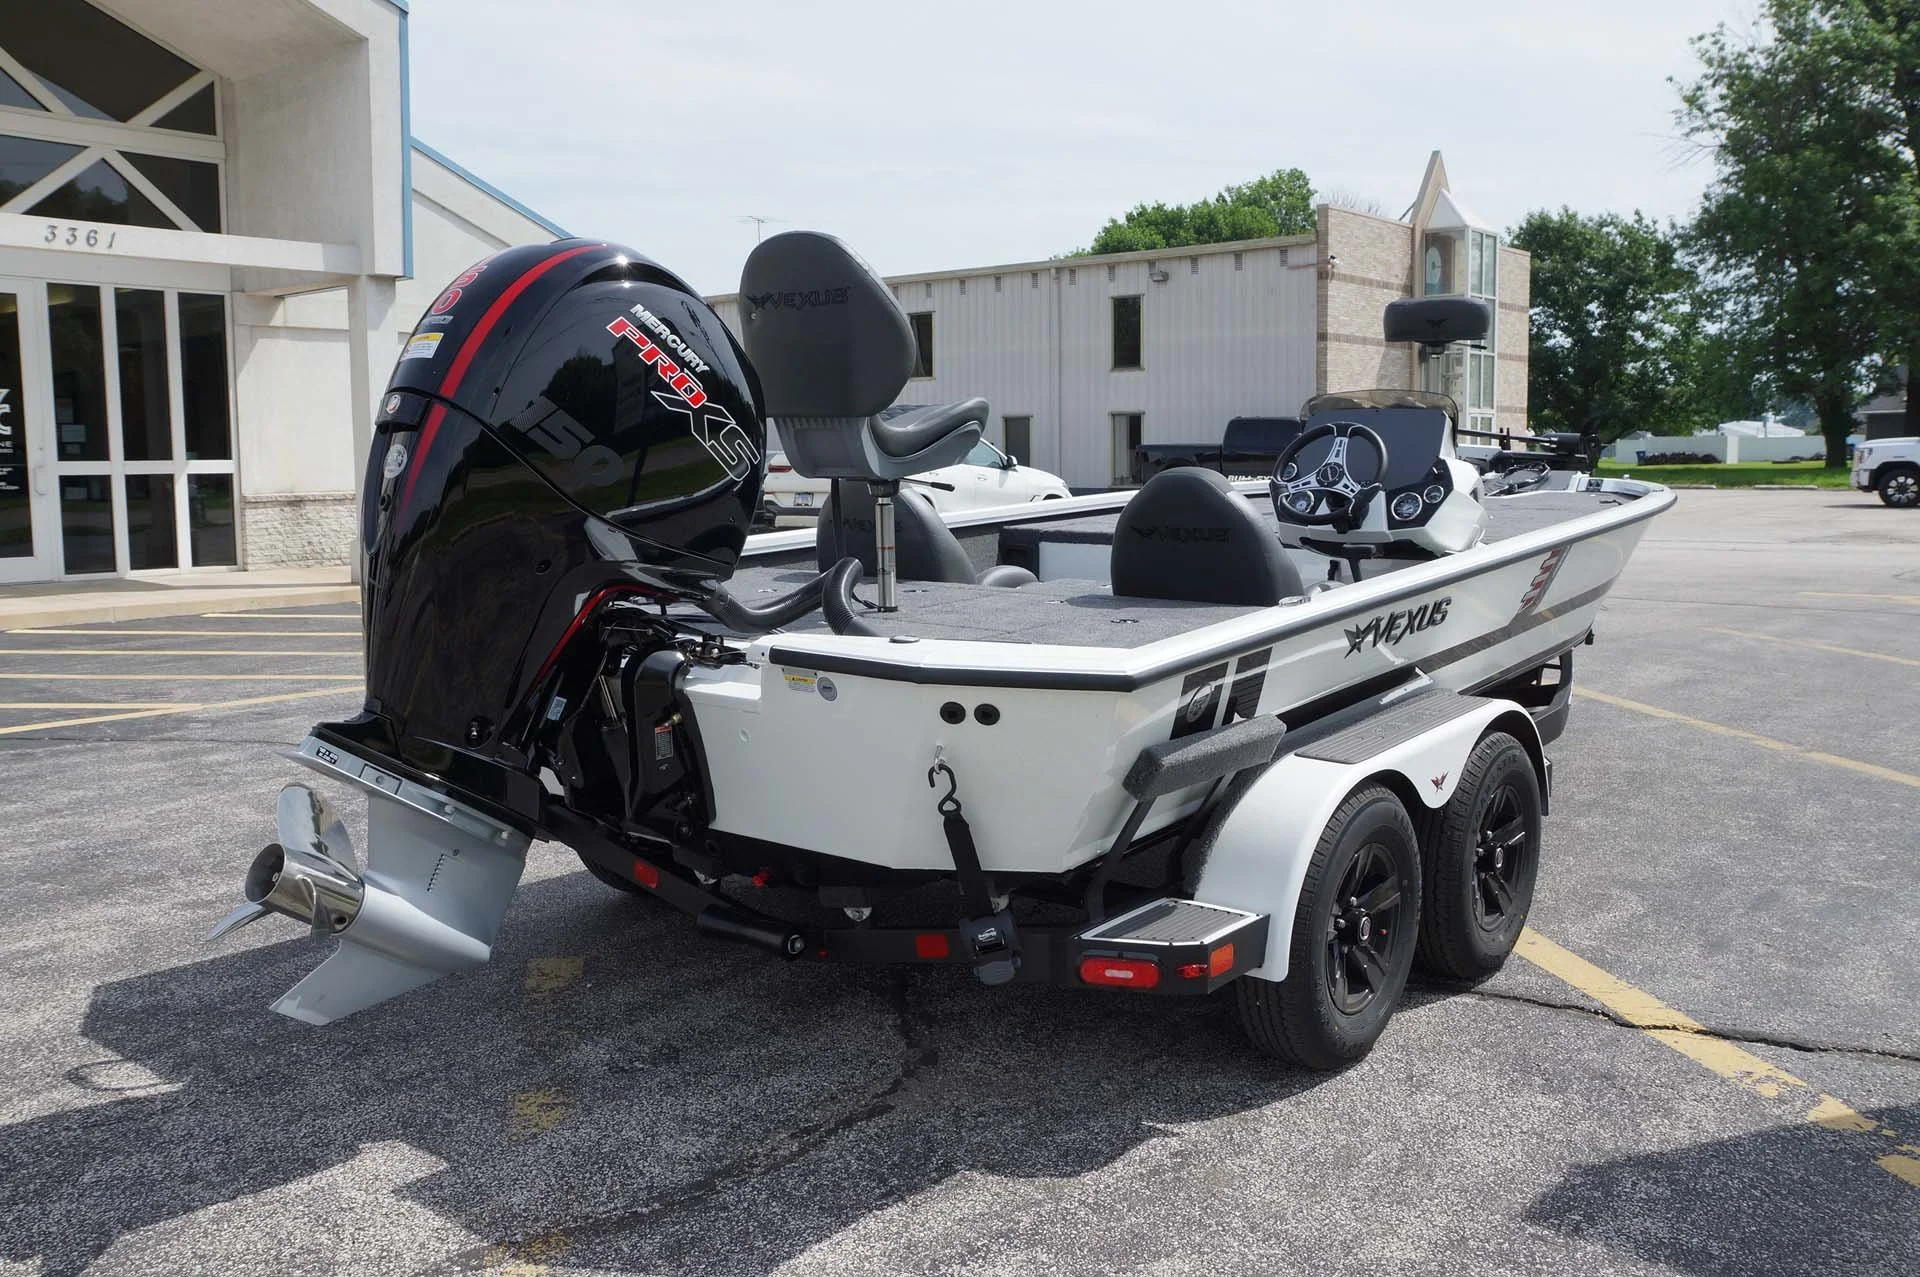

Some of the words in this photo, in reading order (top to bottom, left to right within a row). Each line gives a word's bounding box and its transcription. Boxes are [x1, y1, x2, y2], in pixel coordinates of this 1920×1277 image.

[44, 224, 116, 249] 3361
[605, 316, 708, 409] PRO
[629, 303, 710, 374] MERCURY
[1365, 596, 1453, 648] VEXUS
